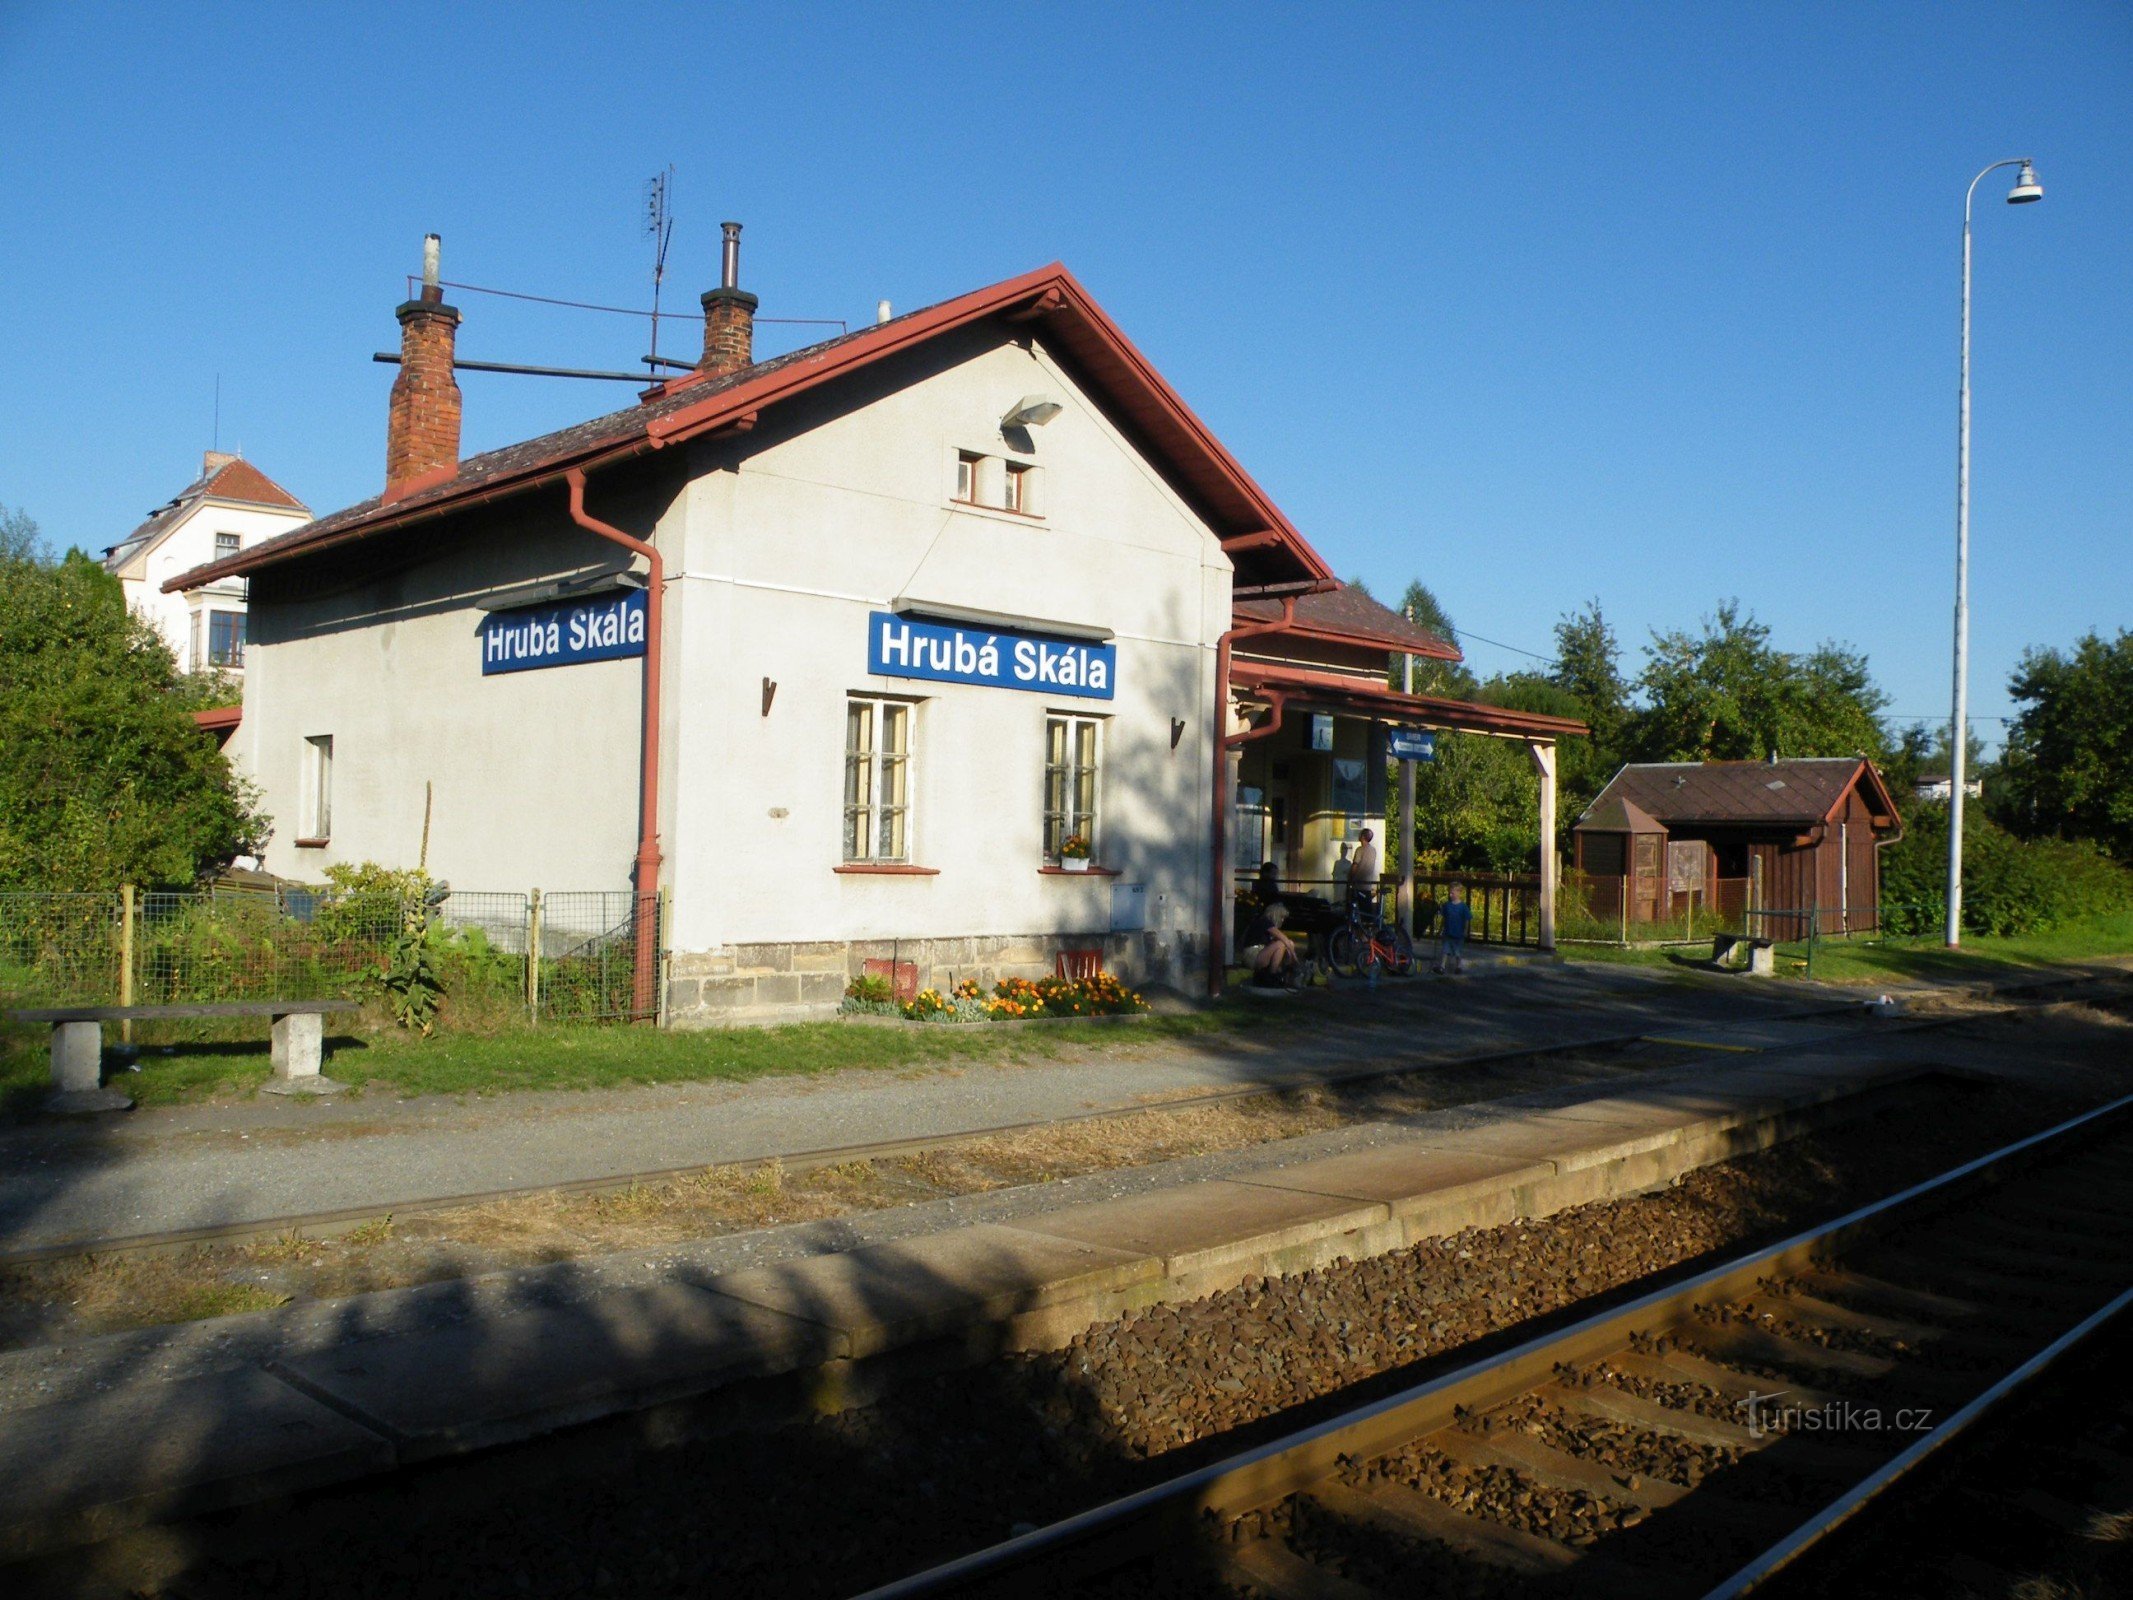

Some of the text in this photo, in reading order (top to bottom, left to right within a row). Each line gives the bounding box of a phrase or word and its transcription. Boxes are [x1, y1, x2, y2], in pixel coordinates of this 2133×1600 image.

[487, 601, 645, 662] Hrubá Skála
[882, 622, 1107, 690] Hrubá Skála
